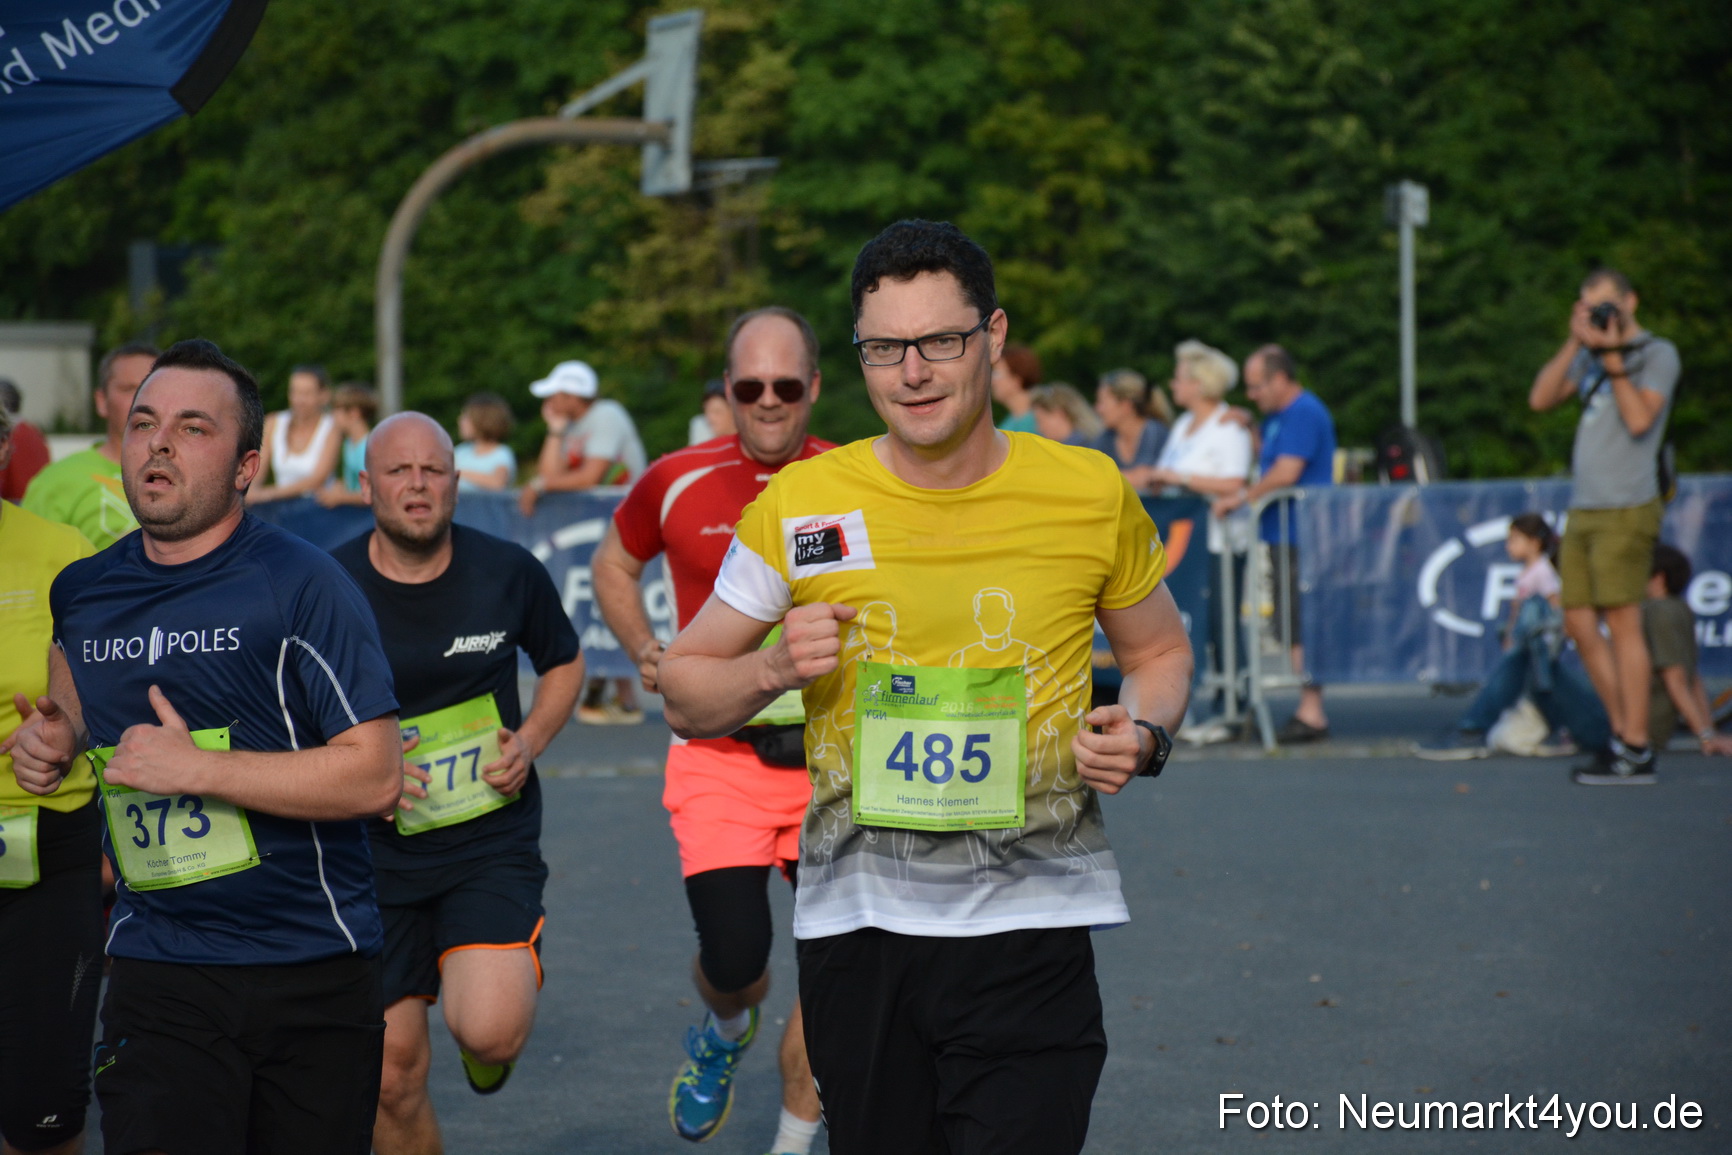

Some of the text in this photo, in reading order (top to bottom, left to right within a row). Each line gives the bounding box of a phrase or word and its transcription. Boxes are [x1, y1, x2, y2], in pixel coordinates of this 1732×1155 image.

[797, 532, 825, 545] my
[797, 544, 824, 561] life
[83, 627, 240, 663] EURO POLES
[881, 690, 939, 706] firmenlauf
[941, 702, 974, 713] 2016
[886, 731, 991, 785] 485
[897, 794, 979, 807] Hannes Klement
[126, 794, 211, 849] 373
[146, 851, 207, 869] Köcher Tommy
